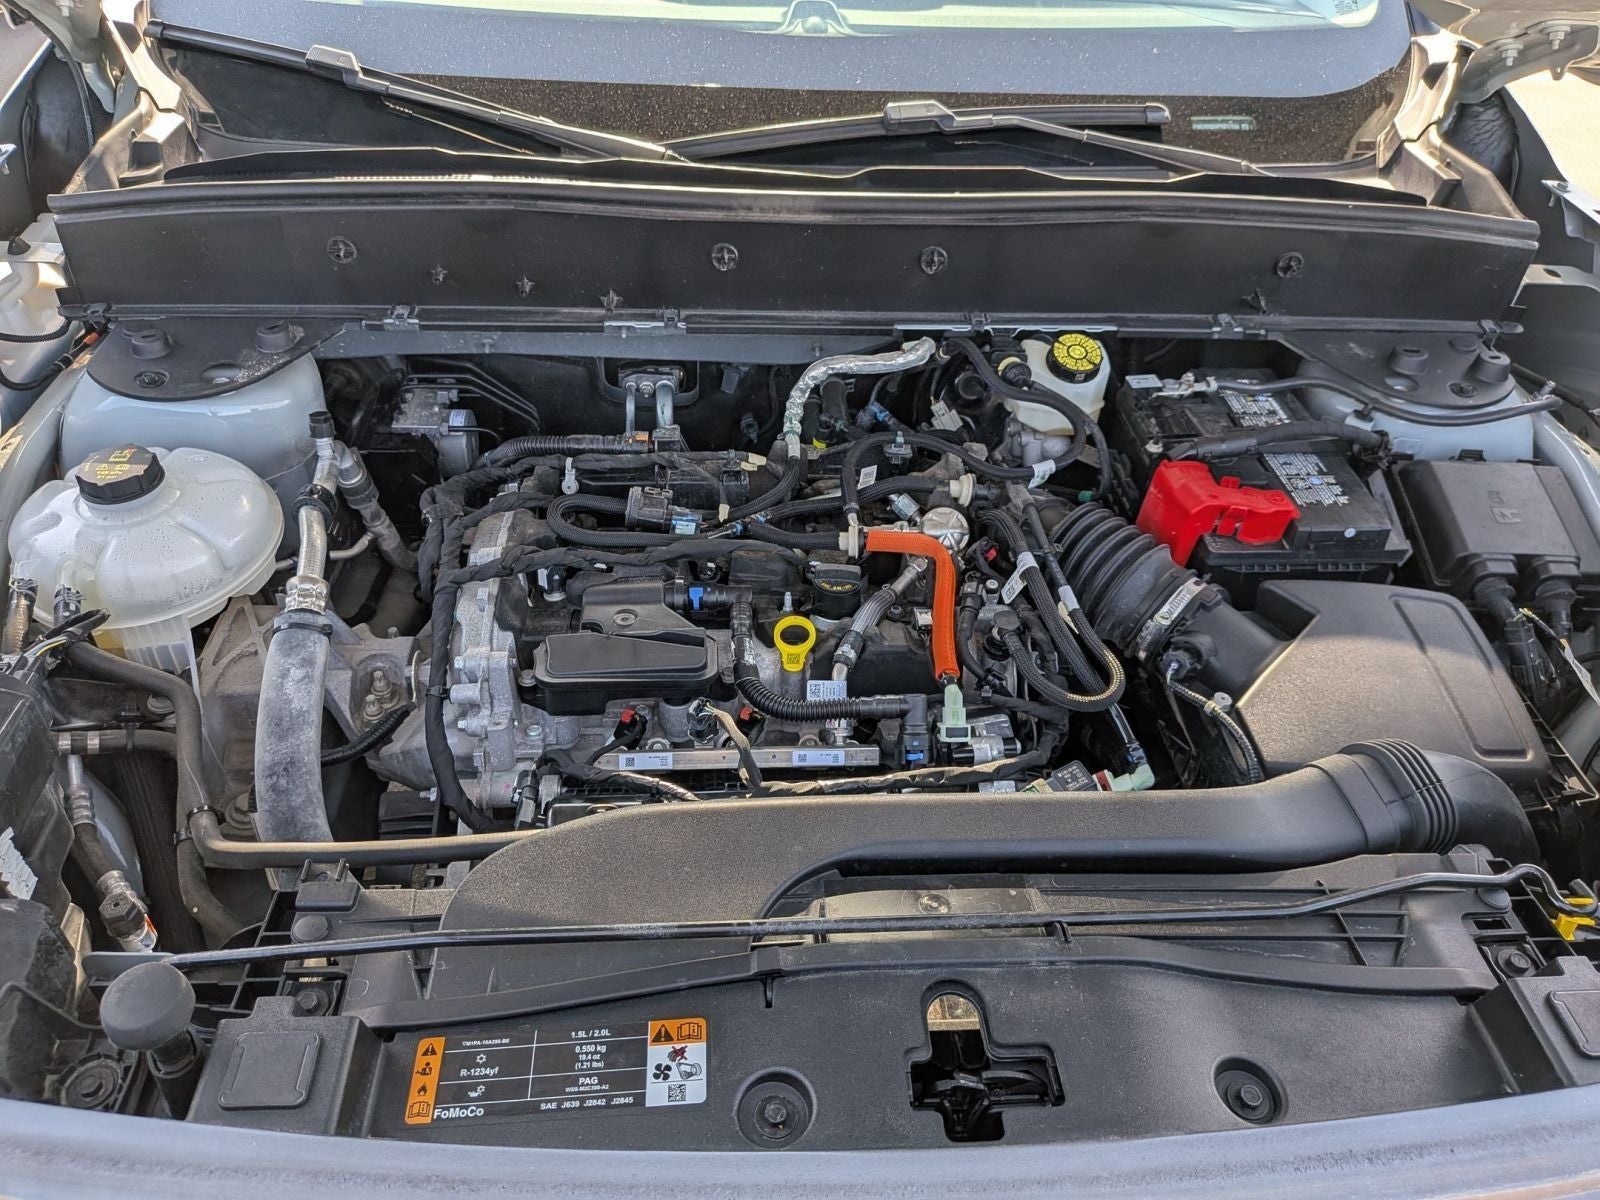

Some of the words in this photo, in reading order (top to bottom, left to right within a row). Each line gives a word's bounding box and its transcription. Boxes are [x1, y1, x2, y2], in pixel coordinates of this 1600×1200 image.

[570, 1030, 588, 1039] 1.5L
[593, 1028, 612, 1037] 2.0L
[575, 1044, 596, 1053] 0.550
[596, 1043, 607, 1053] kg
[460, 1066, 500, 1077] R-1234yf
[578, 1076, 599, 1085] PAG
[540, 1101, 558, 1110] SAE
[561, 1100, 581, 1109] J639
[583, 1098, 607, 1107] J2842
[610, 1096, 634, 1105] J2845
[433, 1106, 485, 1119] FoMoCo
